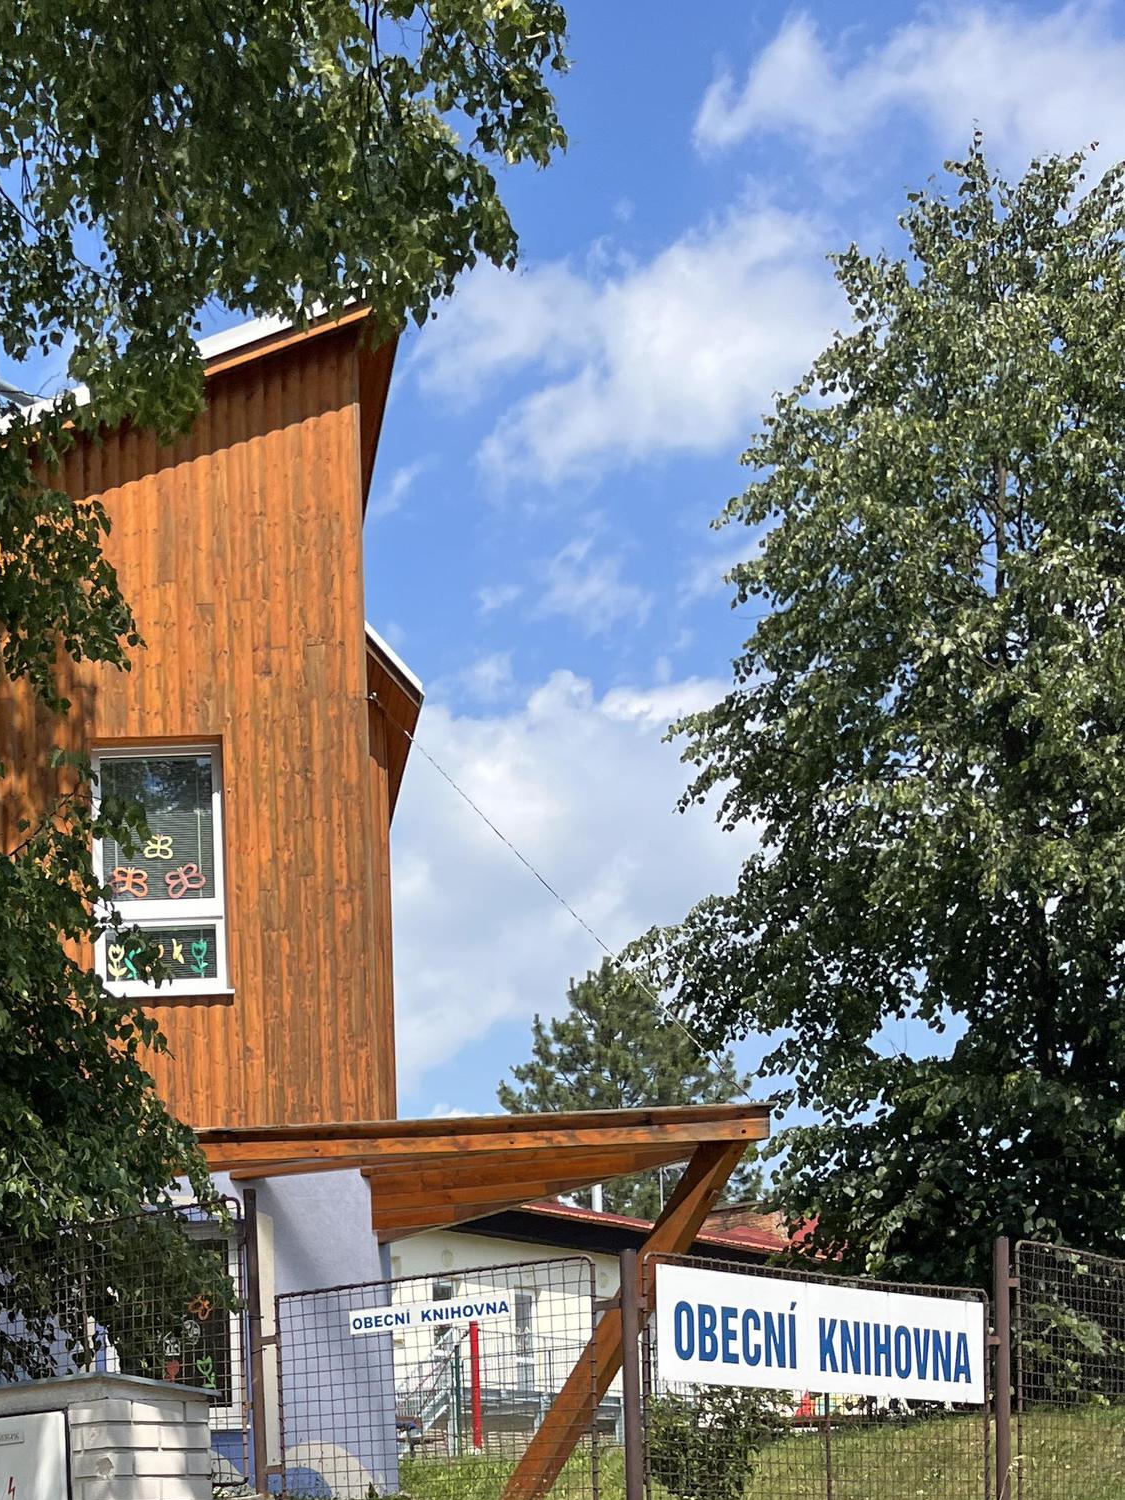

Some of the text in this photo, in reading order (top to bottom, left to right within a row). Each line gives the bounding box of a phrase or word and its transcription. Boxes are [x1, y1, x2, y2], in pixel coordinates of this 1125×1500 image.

[353, 1301, 509, 1329] OBECNÍ KNIHOVNA
[674, 1301, 972, 1383] OBECNÍ KNIHOVNA
